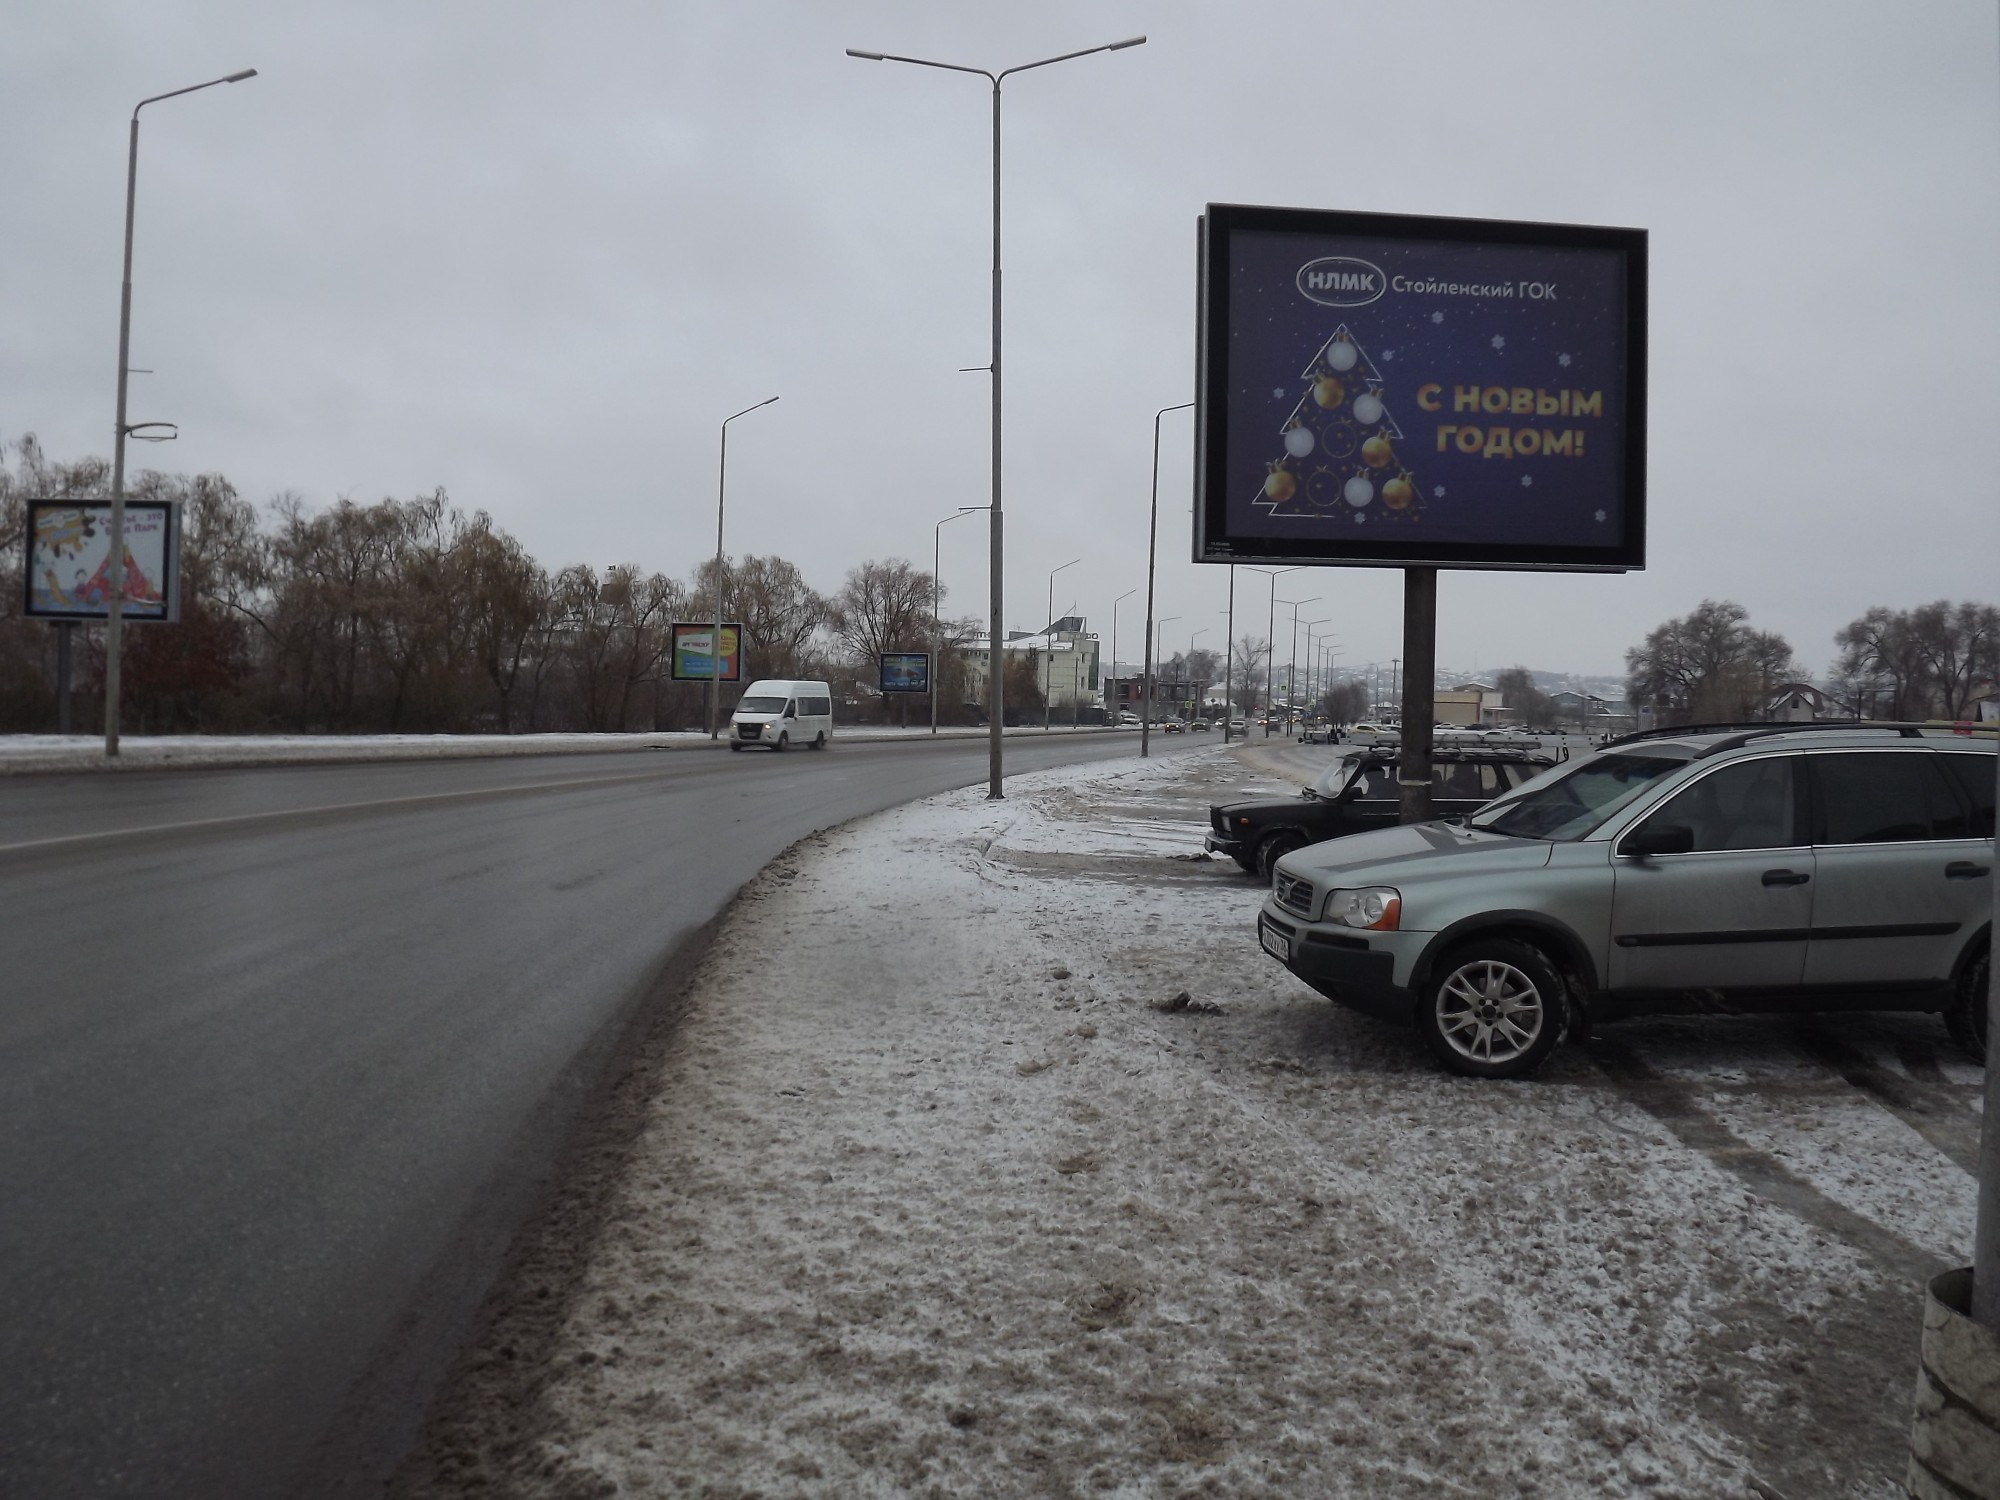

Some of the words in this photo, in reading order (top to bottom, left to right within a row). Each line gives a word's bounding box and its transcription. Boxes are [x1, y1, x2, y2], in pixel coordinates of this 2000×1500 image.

[1308, 271, 1375, 291] НЛМК
[1392, 275, 1513, 298] Стойленский
[1518, 282, 1557, 300] ГОК
[1416, 383, 1442, 412] С
[1454, 385, 1602, 417] НОВЫМ
[1437, 425, 1585, 459] ГОДОМ!
